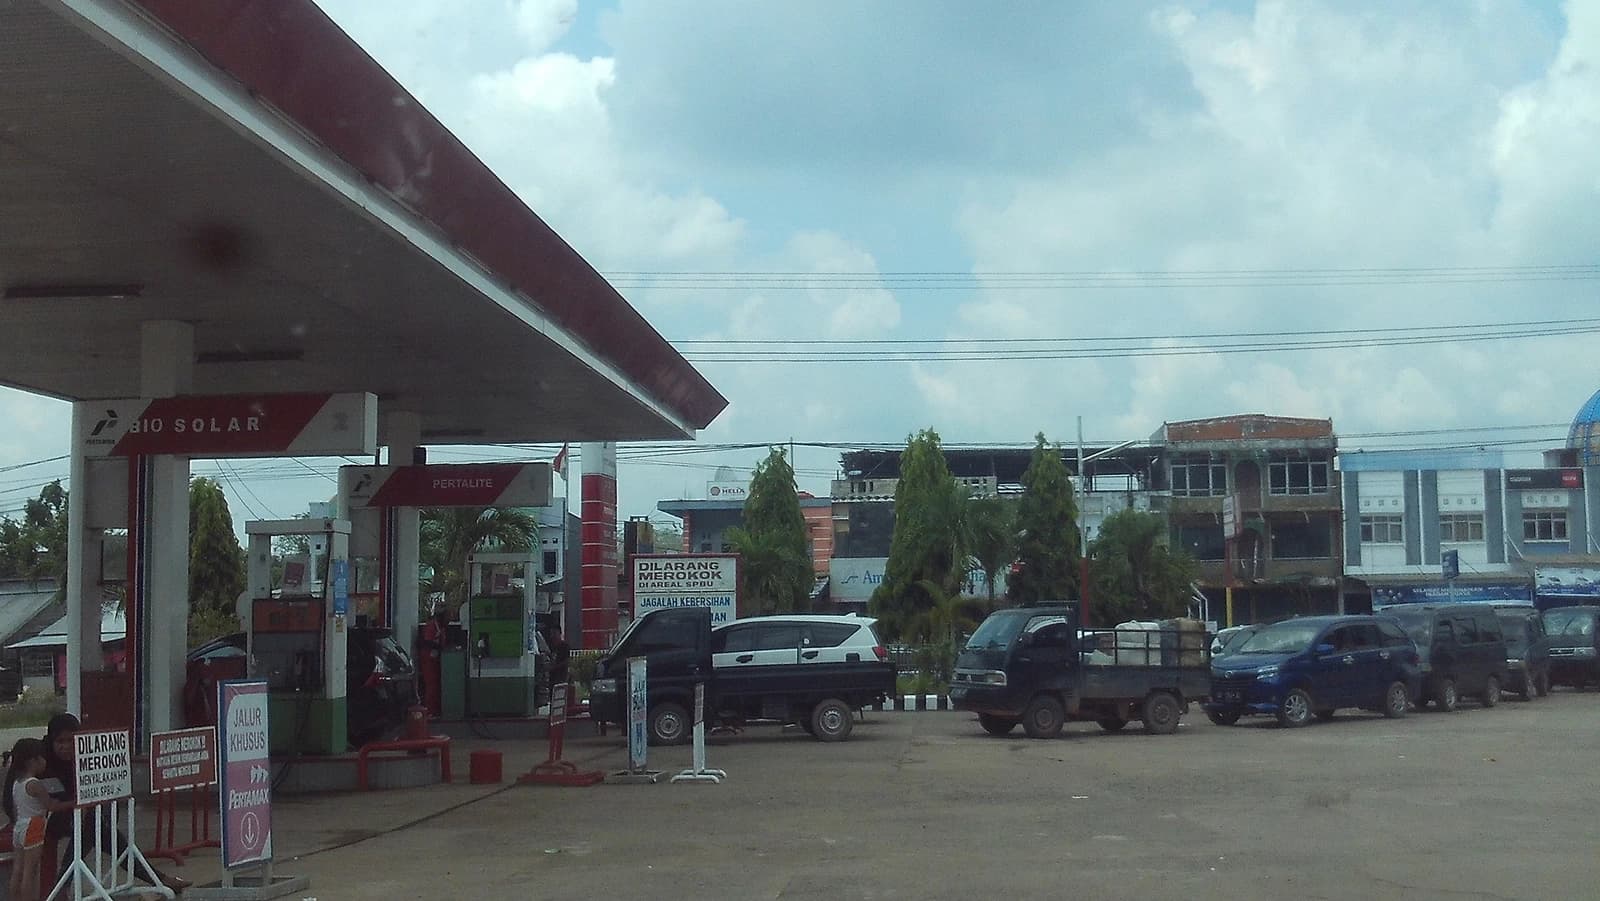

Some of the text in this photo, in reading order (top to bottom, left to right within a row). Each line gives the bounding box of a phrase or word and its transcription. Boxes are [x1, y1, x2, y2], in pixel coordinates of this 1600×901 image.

[128, 417, 261, 433] BIO SOLAR
[432, 479, 493, 489] PERTALITE
[639, 562, 719, 571] DILARANG
[639, 571, 722, 580] MEROKOK
[640, 596, 730, 607] JAGALAH KEBERSIHAN
[233, 707, 262, 728] JALUR
[78, 733, 126, 754] DILARANG
[230, 731, 265, 752] KHUSUS
[80, 752, 127, 772] MEROKOK
[228, 788, 270, 811] PERTAMAX
